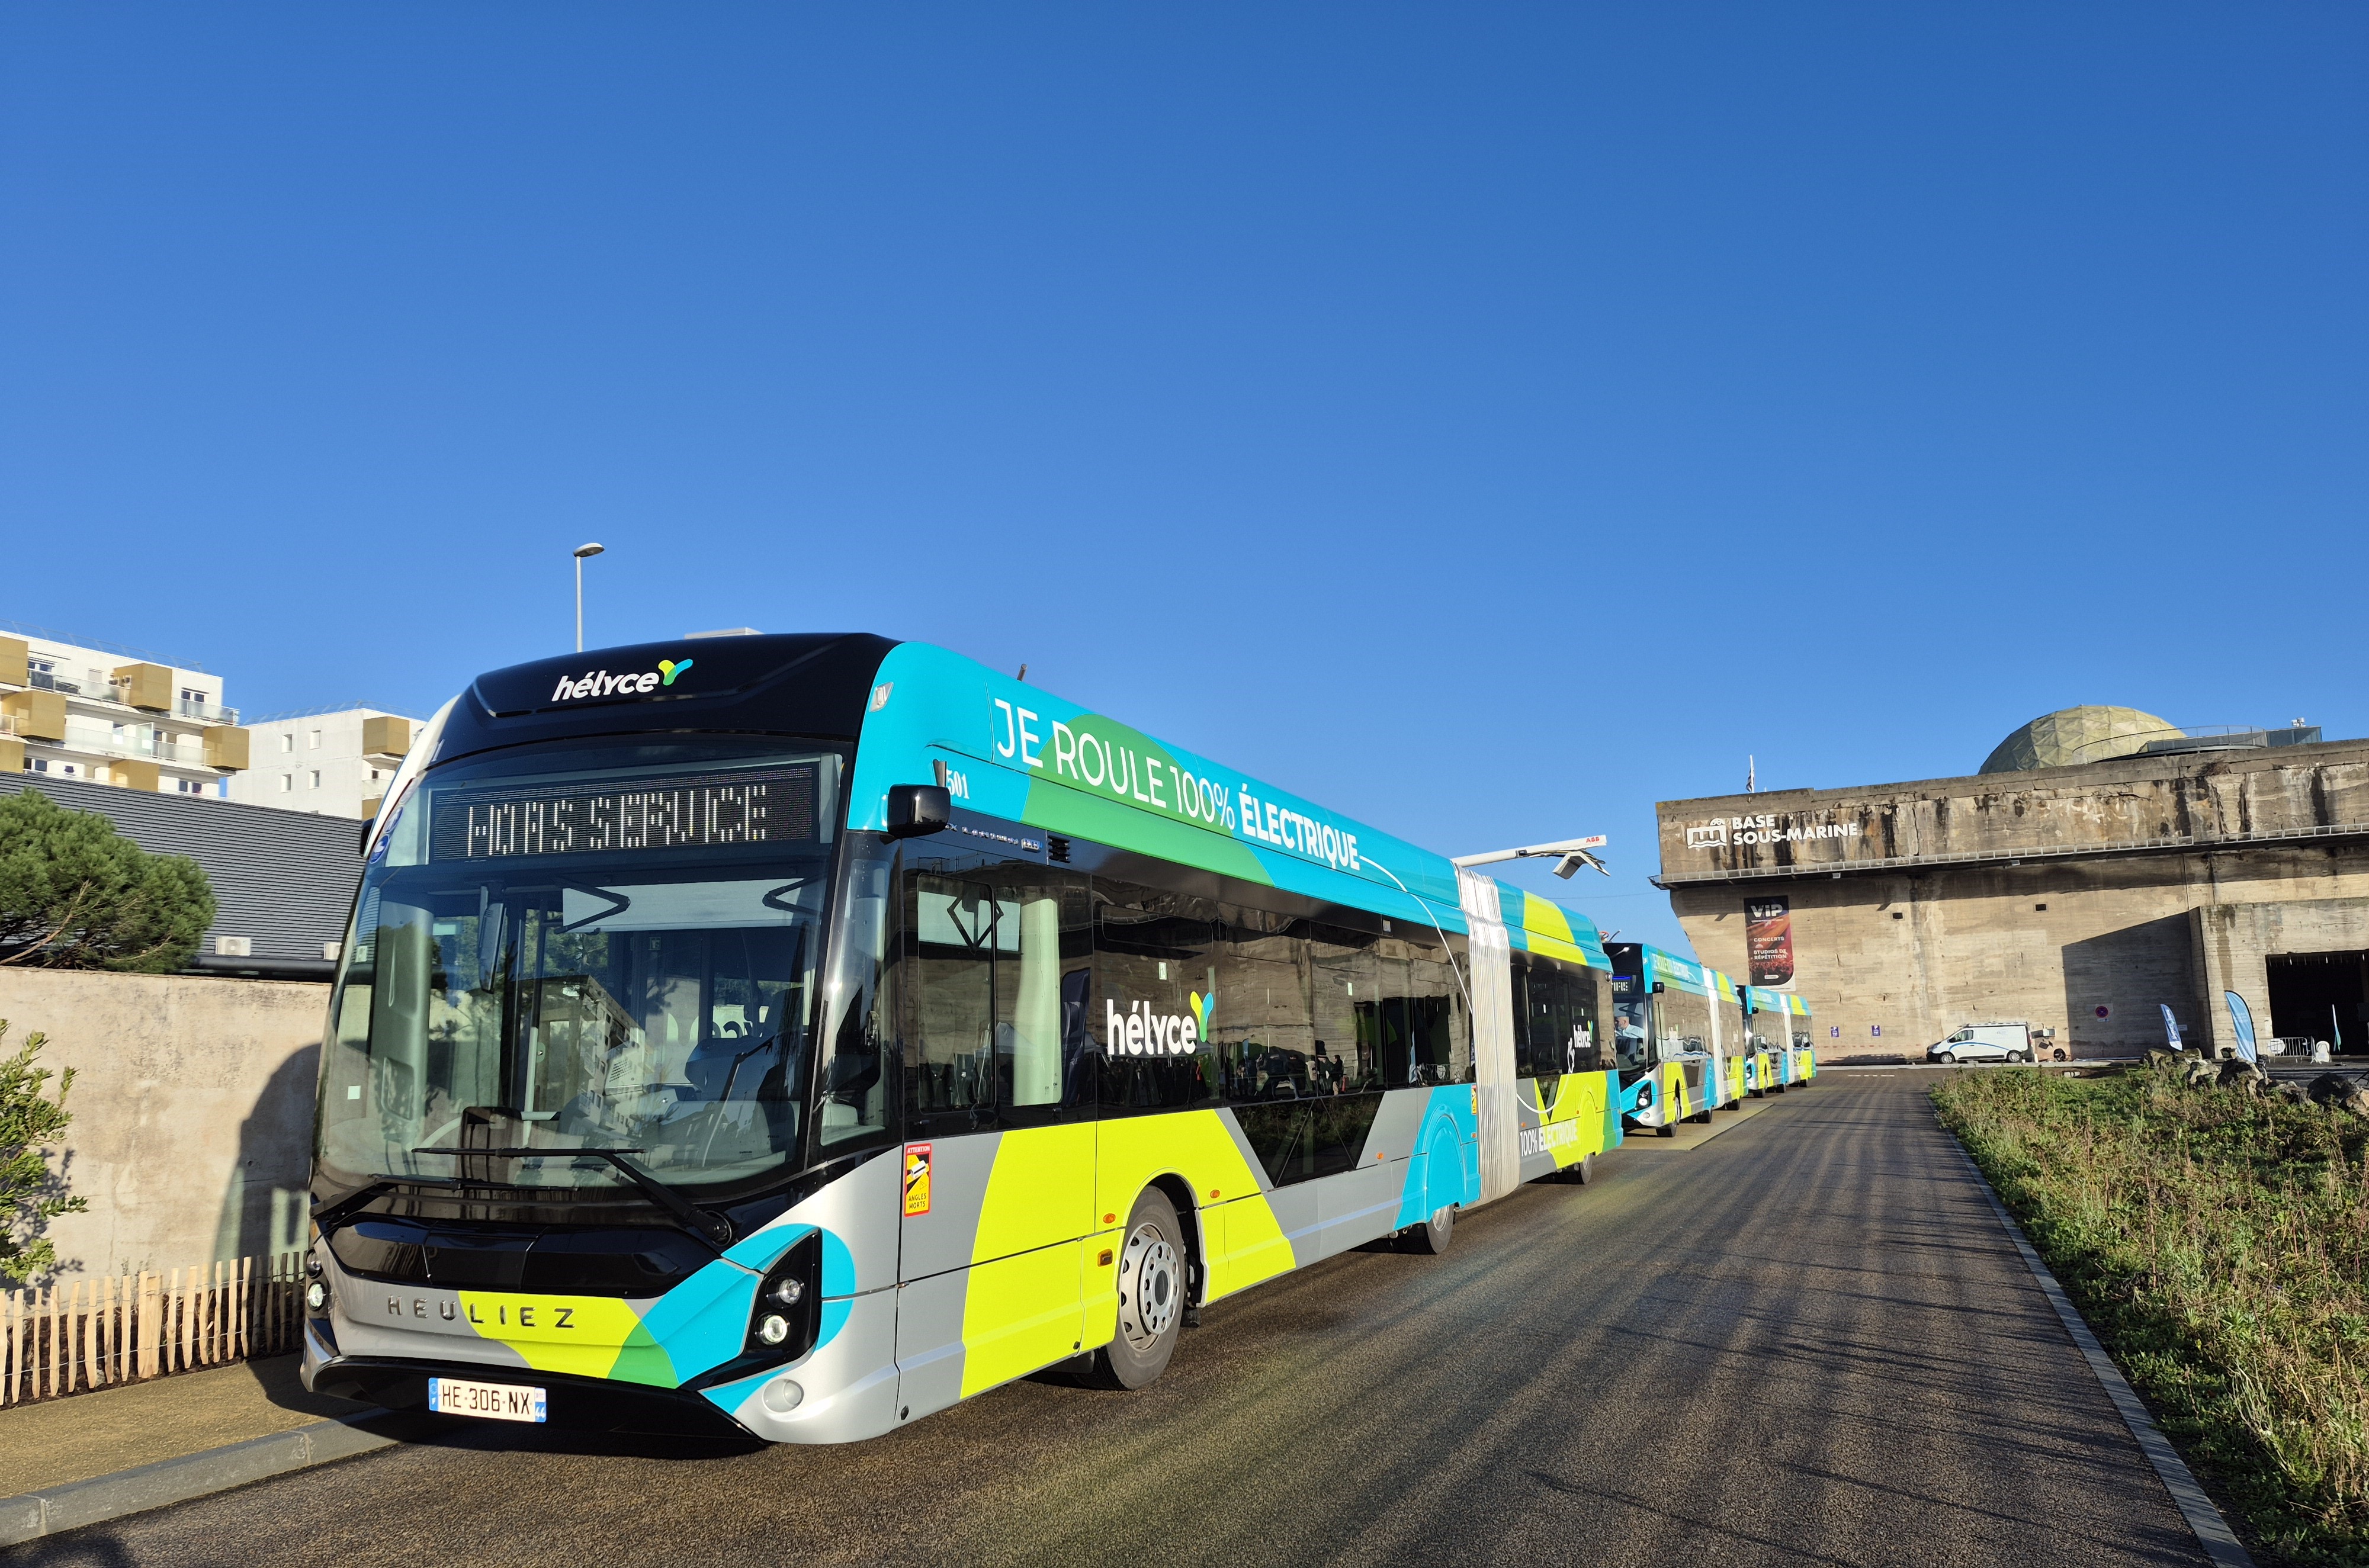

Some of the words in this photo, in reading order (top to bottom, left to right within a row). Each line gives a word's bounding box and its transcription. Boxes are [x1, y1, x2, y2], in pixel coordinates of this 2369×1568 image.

[551, 670, 659, 702] hélyce
[994, 698, 1044, 769] JE
[1052, 720, 1167, 809] ROULE
[1169, 765, 1235, 830] 100%
[1238, 783, 1360, 870] ÉLECTRIQUE
[590, 785, 766, 849] SERVICE
[1732, 814, 1775, 830] BASE
[1733, 823, 1858, 846] SOUS-MARINE
[1107, 998, 1197, 1055] hélyce
[1573, 1024, 1591, 1048] hélyce
[907, 1145, 930, 1153] ATTENTION
[1520, 1128, 1537, 1156] 100%
[909, 1193, 927, 1202] ANGLES
[909, 1201, 926, 1210] MORTS
[387, 1295, 575, 1328] HEULIEZ
[535, 1406, 545, 1418] 44
